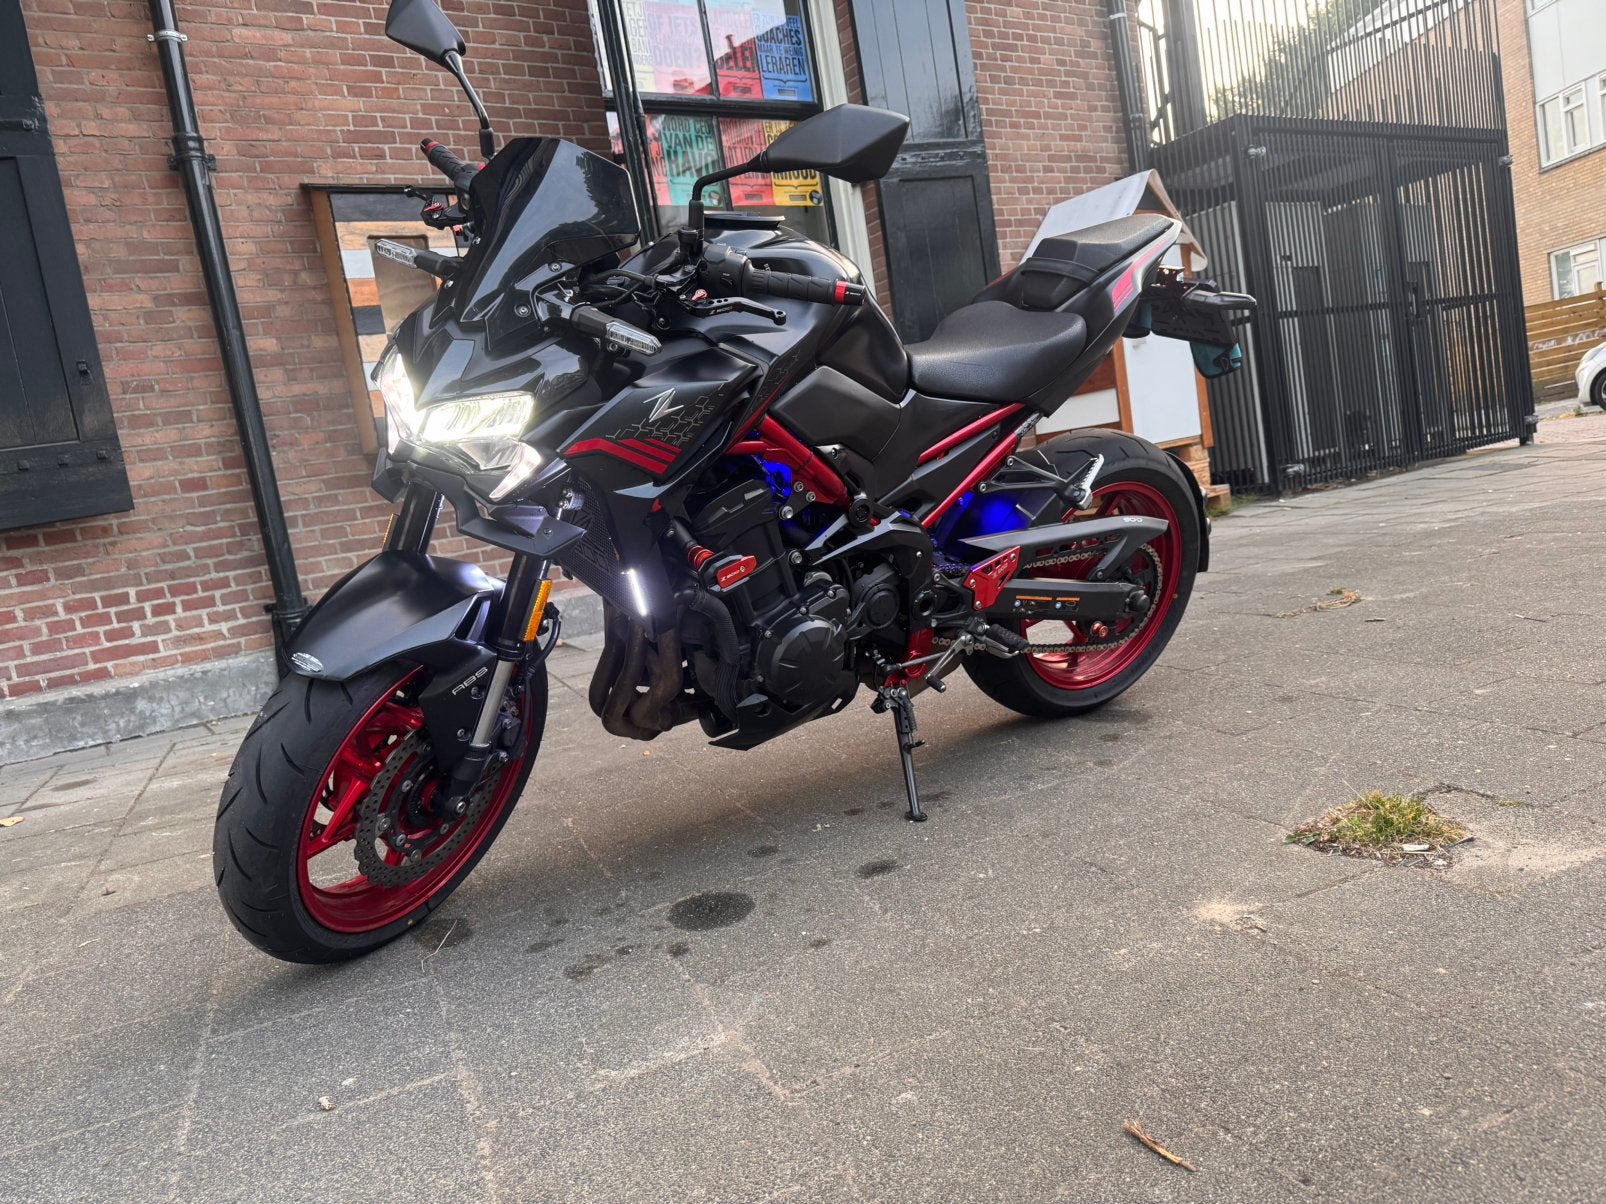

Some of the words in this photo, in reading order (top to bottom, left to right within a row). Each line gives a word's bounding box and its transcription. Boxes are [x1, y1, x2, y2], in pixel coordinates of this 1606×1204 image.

[755, 25, 802, 46] COACHES
[757, 42, 774, 54] MAAR
[776, 44, 784, 55] TE
[784, 46, 804, 57] WEINIG
[760, 54, 806, 76] LERAREN
[694, 119, 711, 136] CEO
[663, 133, 694, 151] VAN
[694, 135, 715, 152] DE
[667, 150, 717, 177] HAVO
[452, 666, 488, 695] ABS
